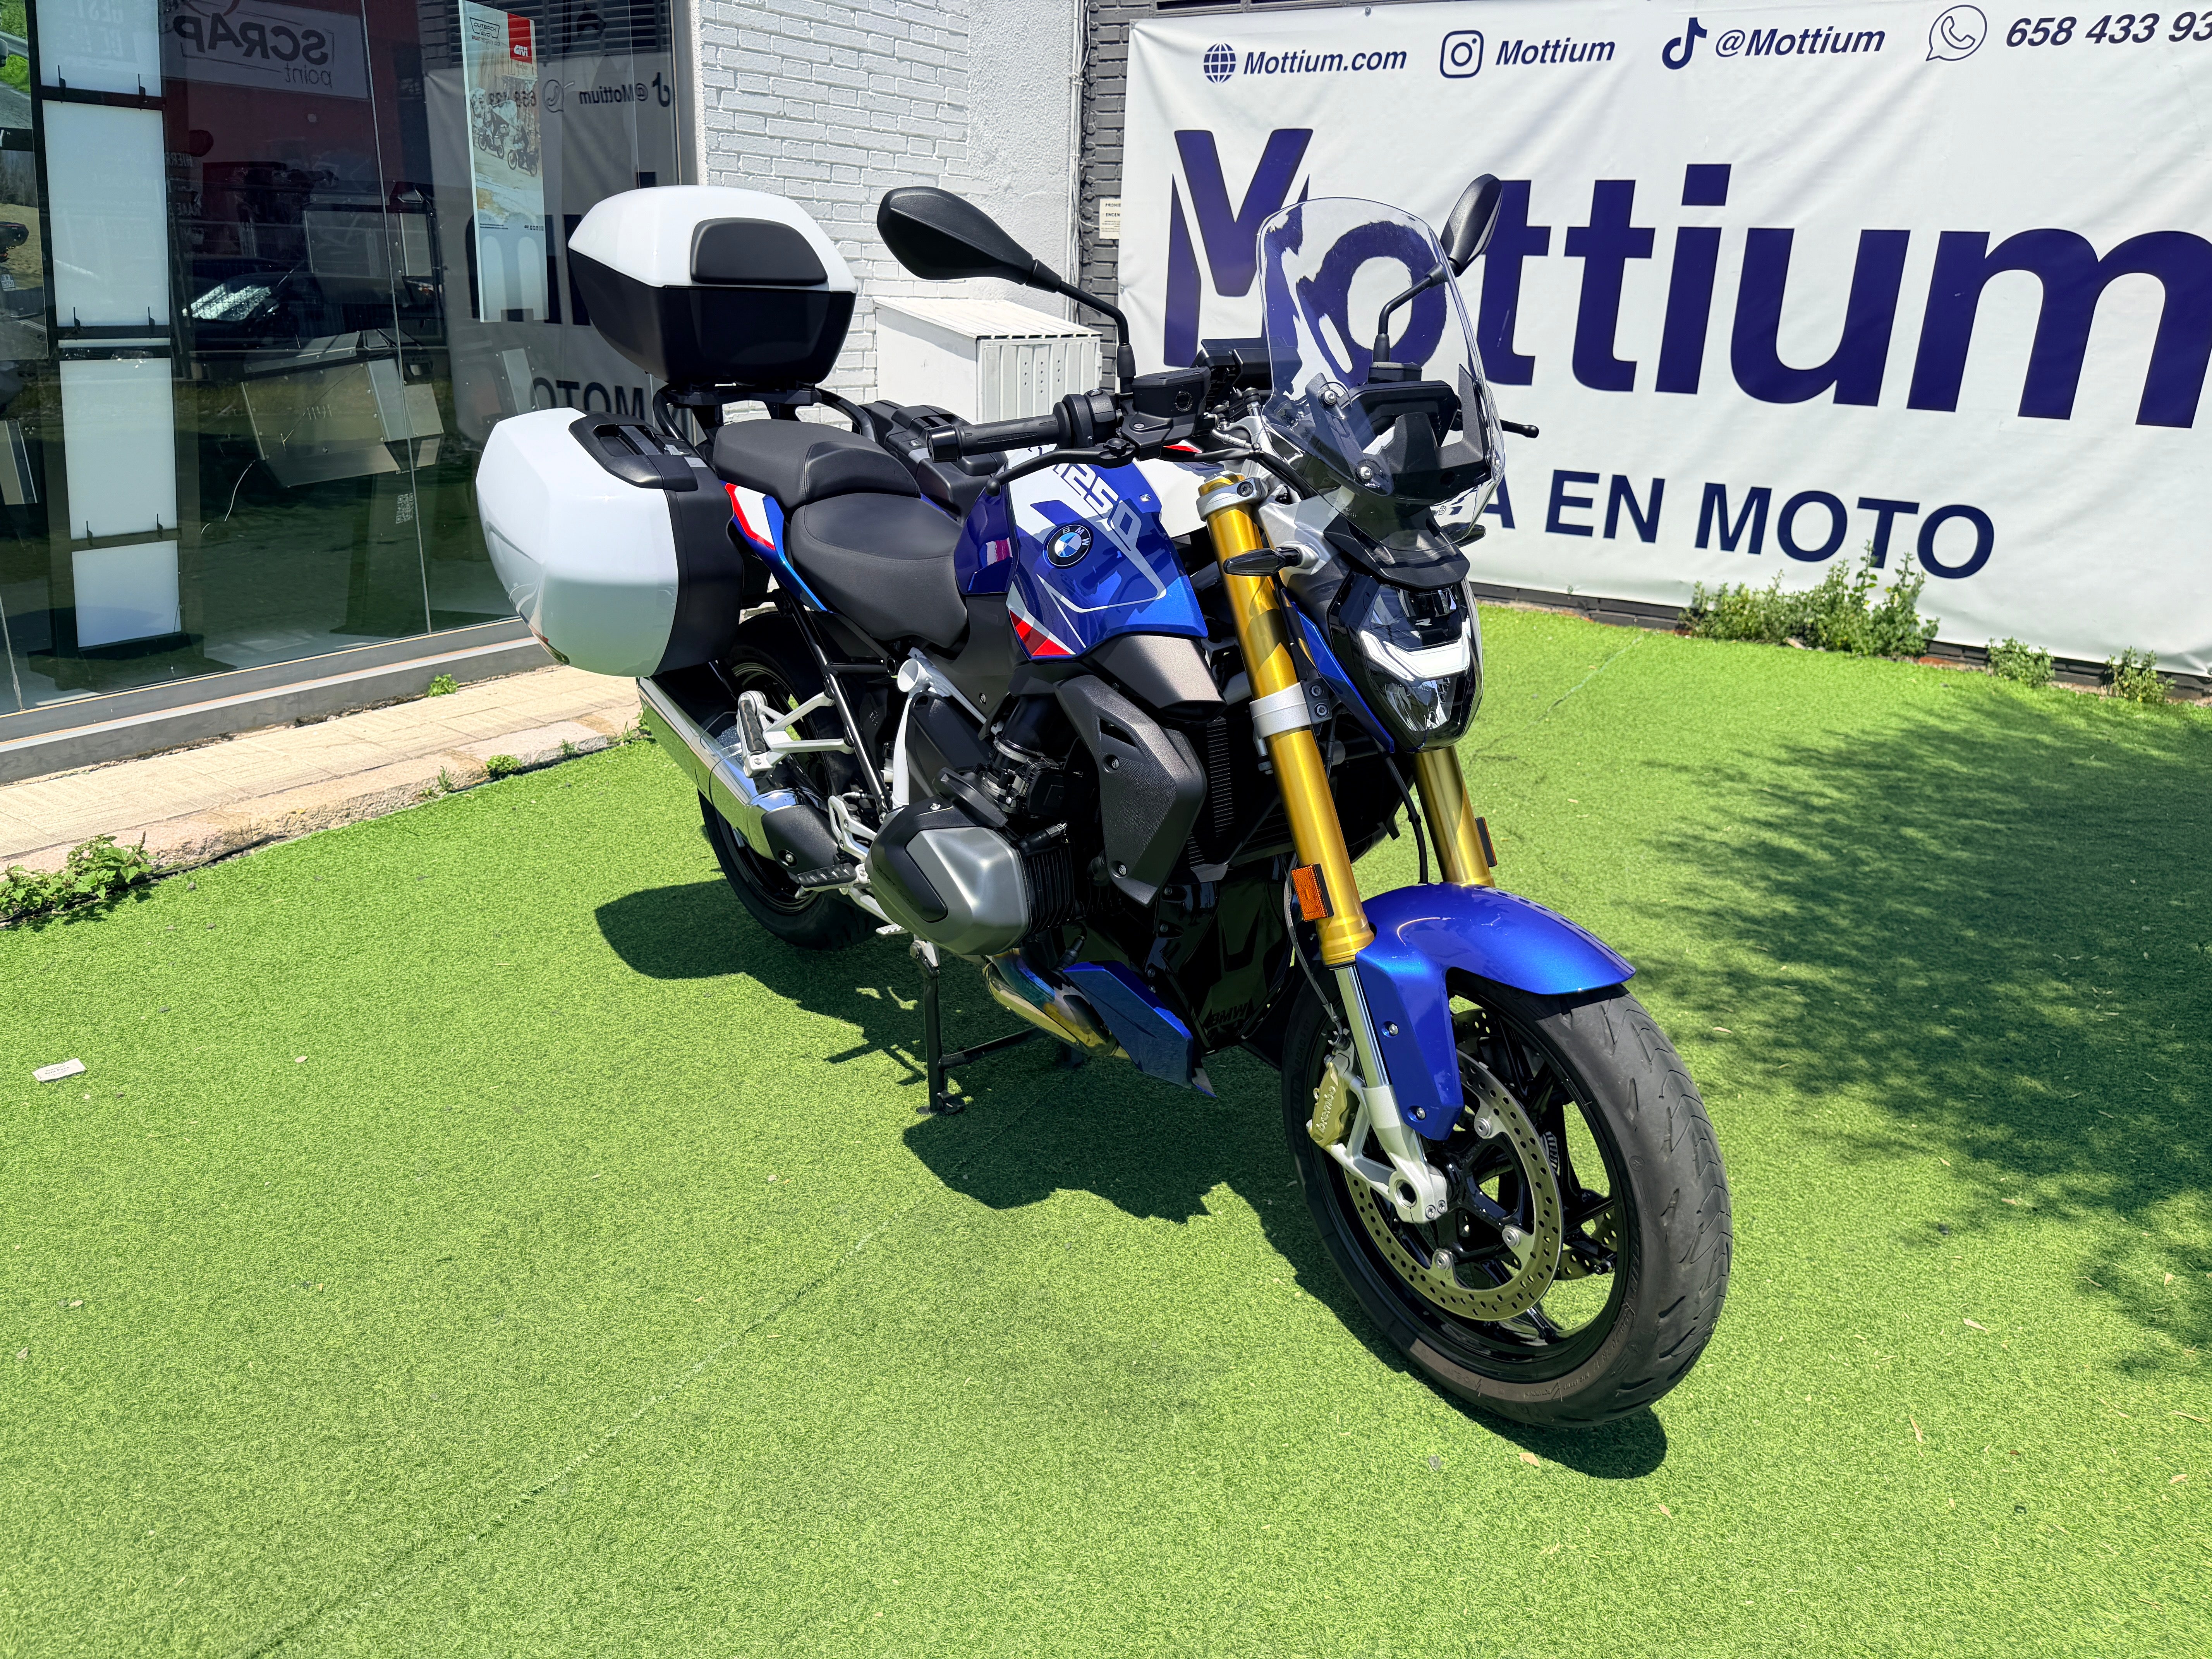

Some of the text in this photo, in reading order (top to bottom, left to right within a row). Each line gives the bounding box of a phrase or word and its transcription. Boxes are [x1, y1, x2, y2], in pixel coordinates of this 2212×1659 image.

[1716, 26, 1885, 57] @Mottium
[2006, 16, 2077, 47] 658
[2085, 13, 2160, 44] 433
[514, 44, 528, 57] GIVI
[1243, 50, 1407, 74] Mottium.com
[1496, 37, 1615, 65] Mottium
[1163, 128, 2212, 428] Mottium
[1062, 526, 1091, 546] BMW
[1546, 470, 1665, 543] EN
[1695, 482, 1994, 579] MOTO
[1316, 1085, 1336, 1134] brembo
